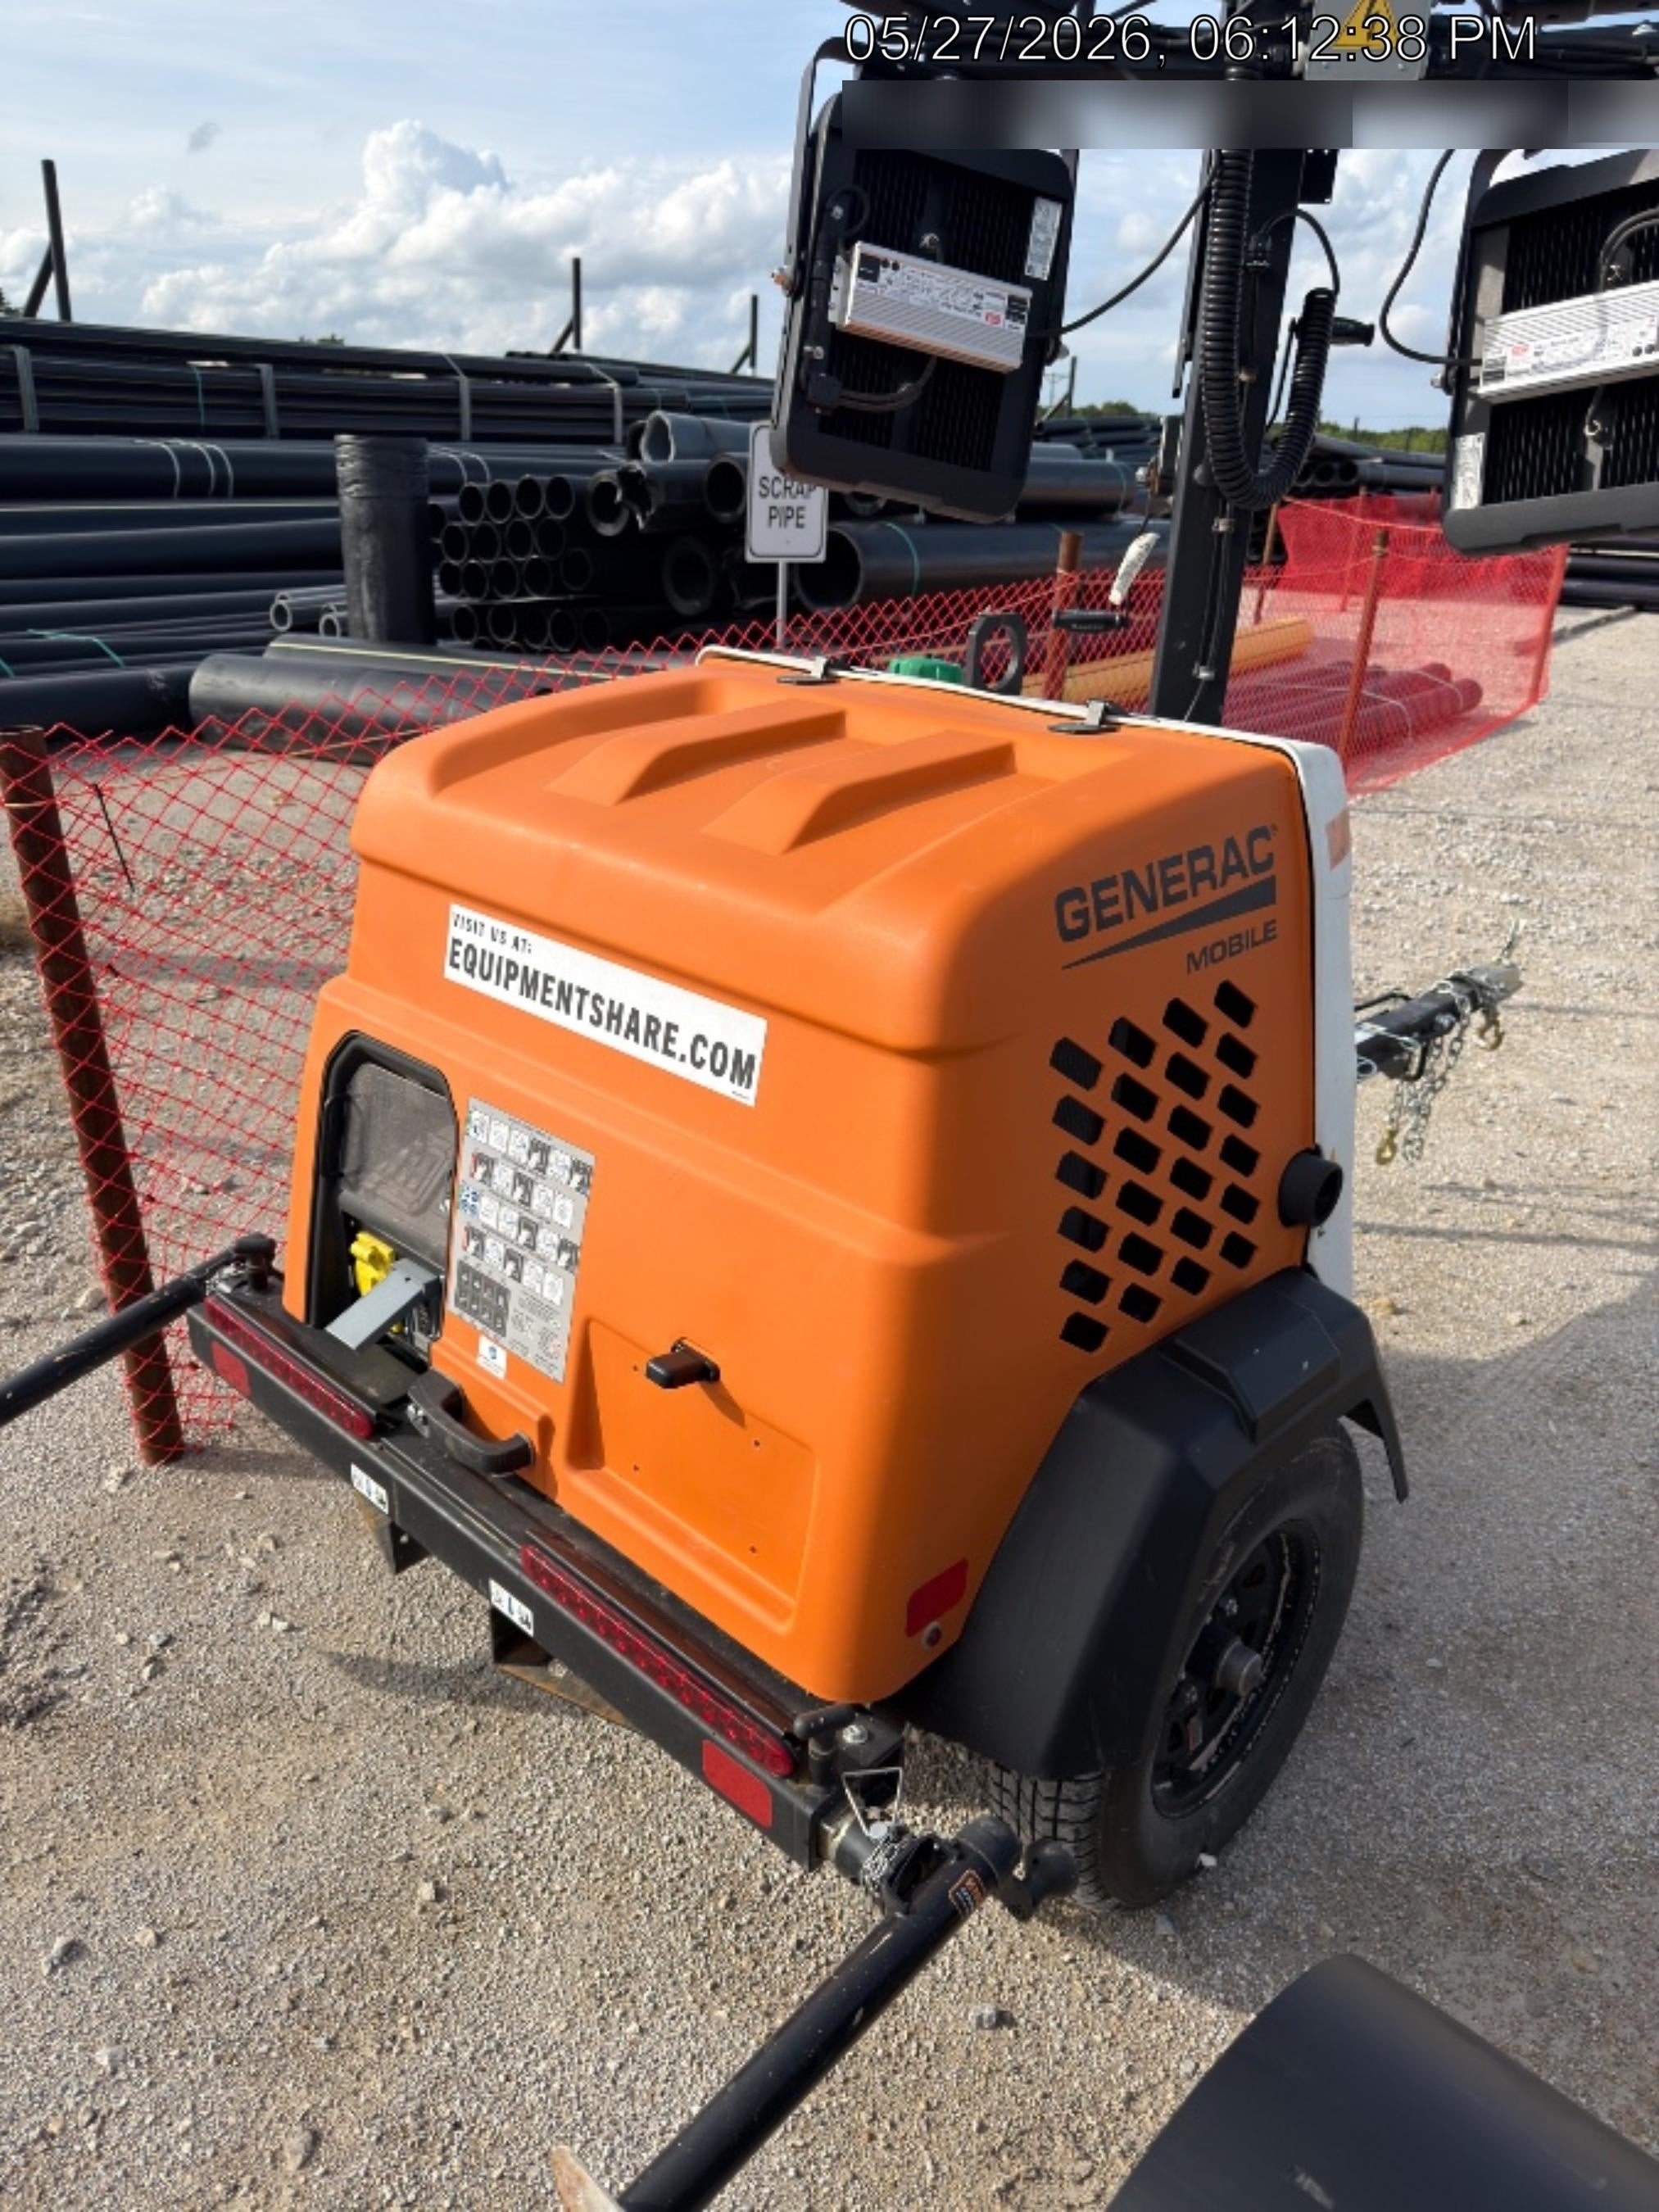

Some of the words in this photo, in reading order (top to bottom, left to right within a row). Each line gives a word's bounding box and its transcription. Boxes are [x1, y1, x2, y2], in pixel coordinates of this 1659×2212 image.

[768, 505, 806, 528] PIPE
[1055, 824, 1276, 943] GENERAC
[452, 911, 485, 937] VISIT
[491, 926, 507, 945] US
[511, 936, 532, 954] AT:
[1185, 918, 1278, 975] MOBILE
[448, 936, 756, 1091] EQUIPMENTSHARE.COM
